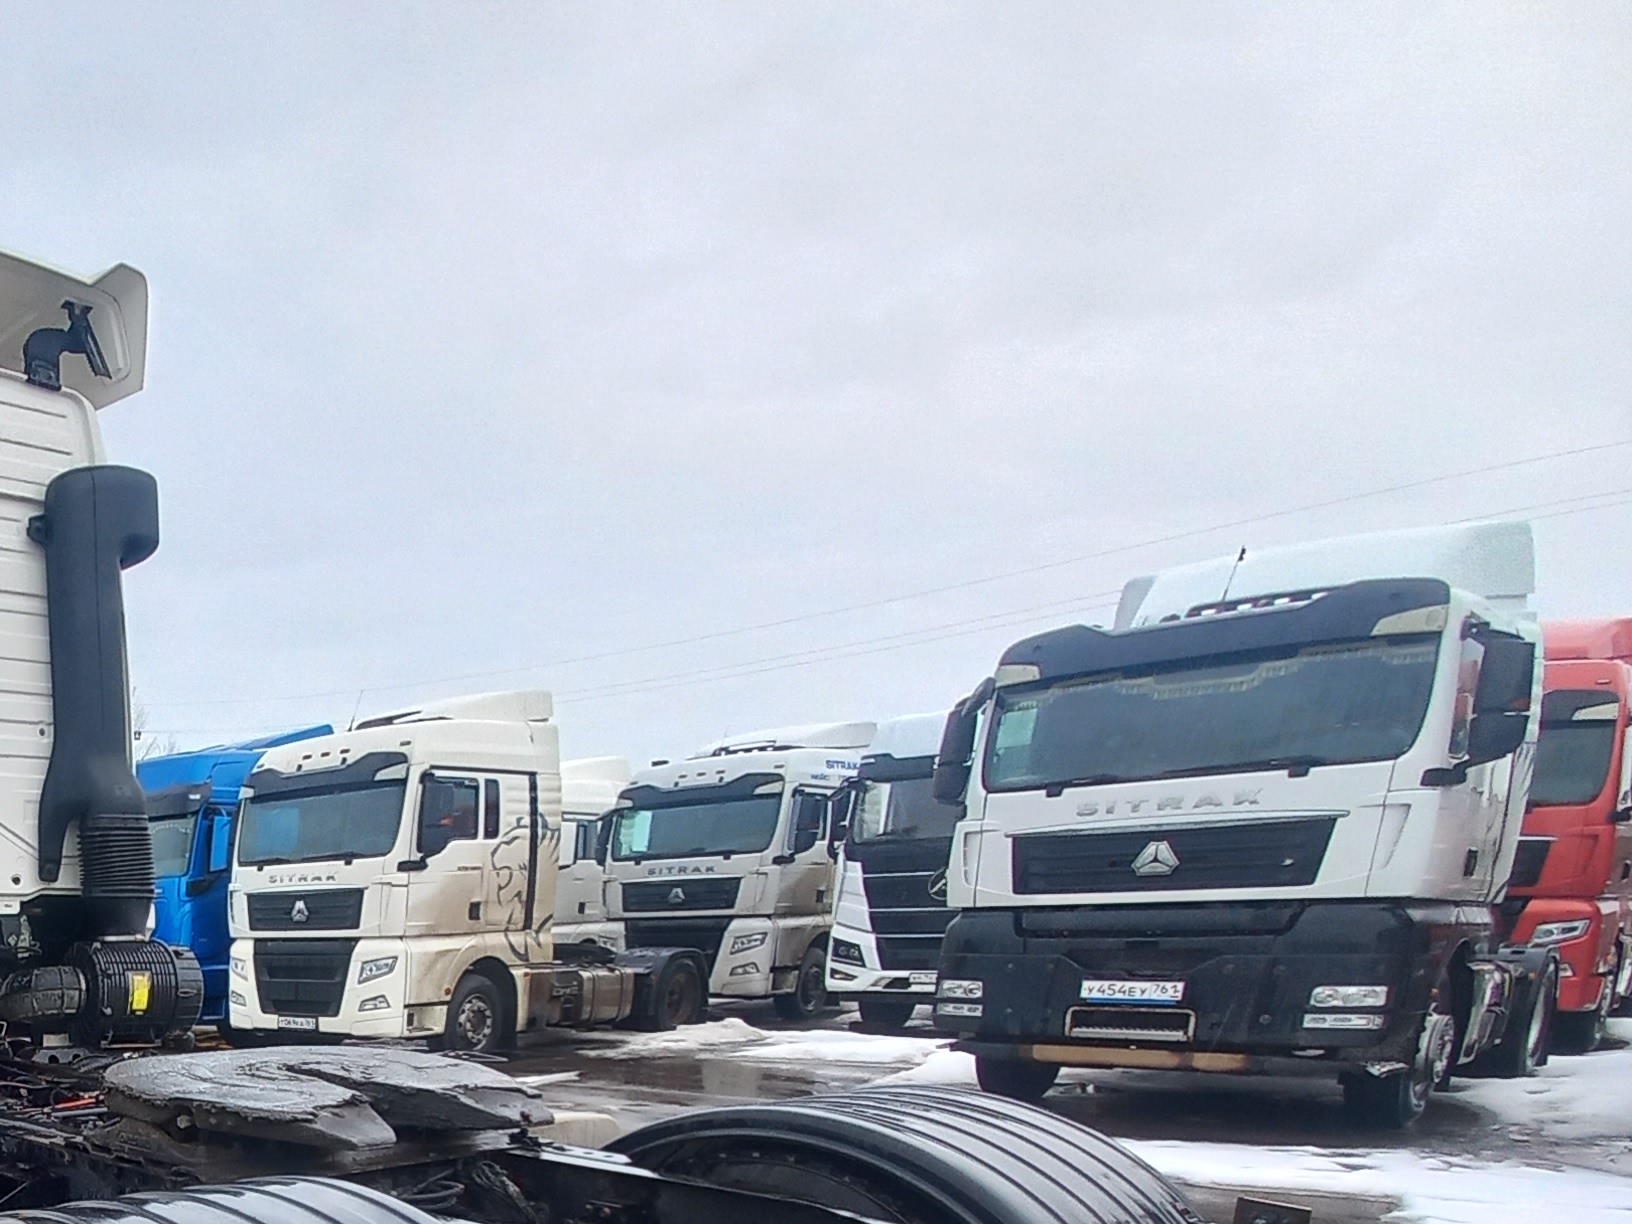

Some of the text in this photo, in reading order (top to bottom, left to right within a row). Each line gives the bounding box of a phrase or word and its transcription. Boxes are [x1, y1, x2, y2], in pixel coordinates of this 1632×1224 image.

[1076, 788, 1263, 817] SITRAK
[268, 871, 339, 884] SITRAK
[648, 866, 715, 876] SITRAK
